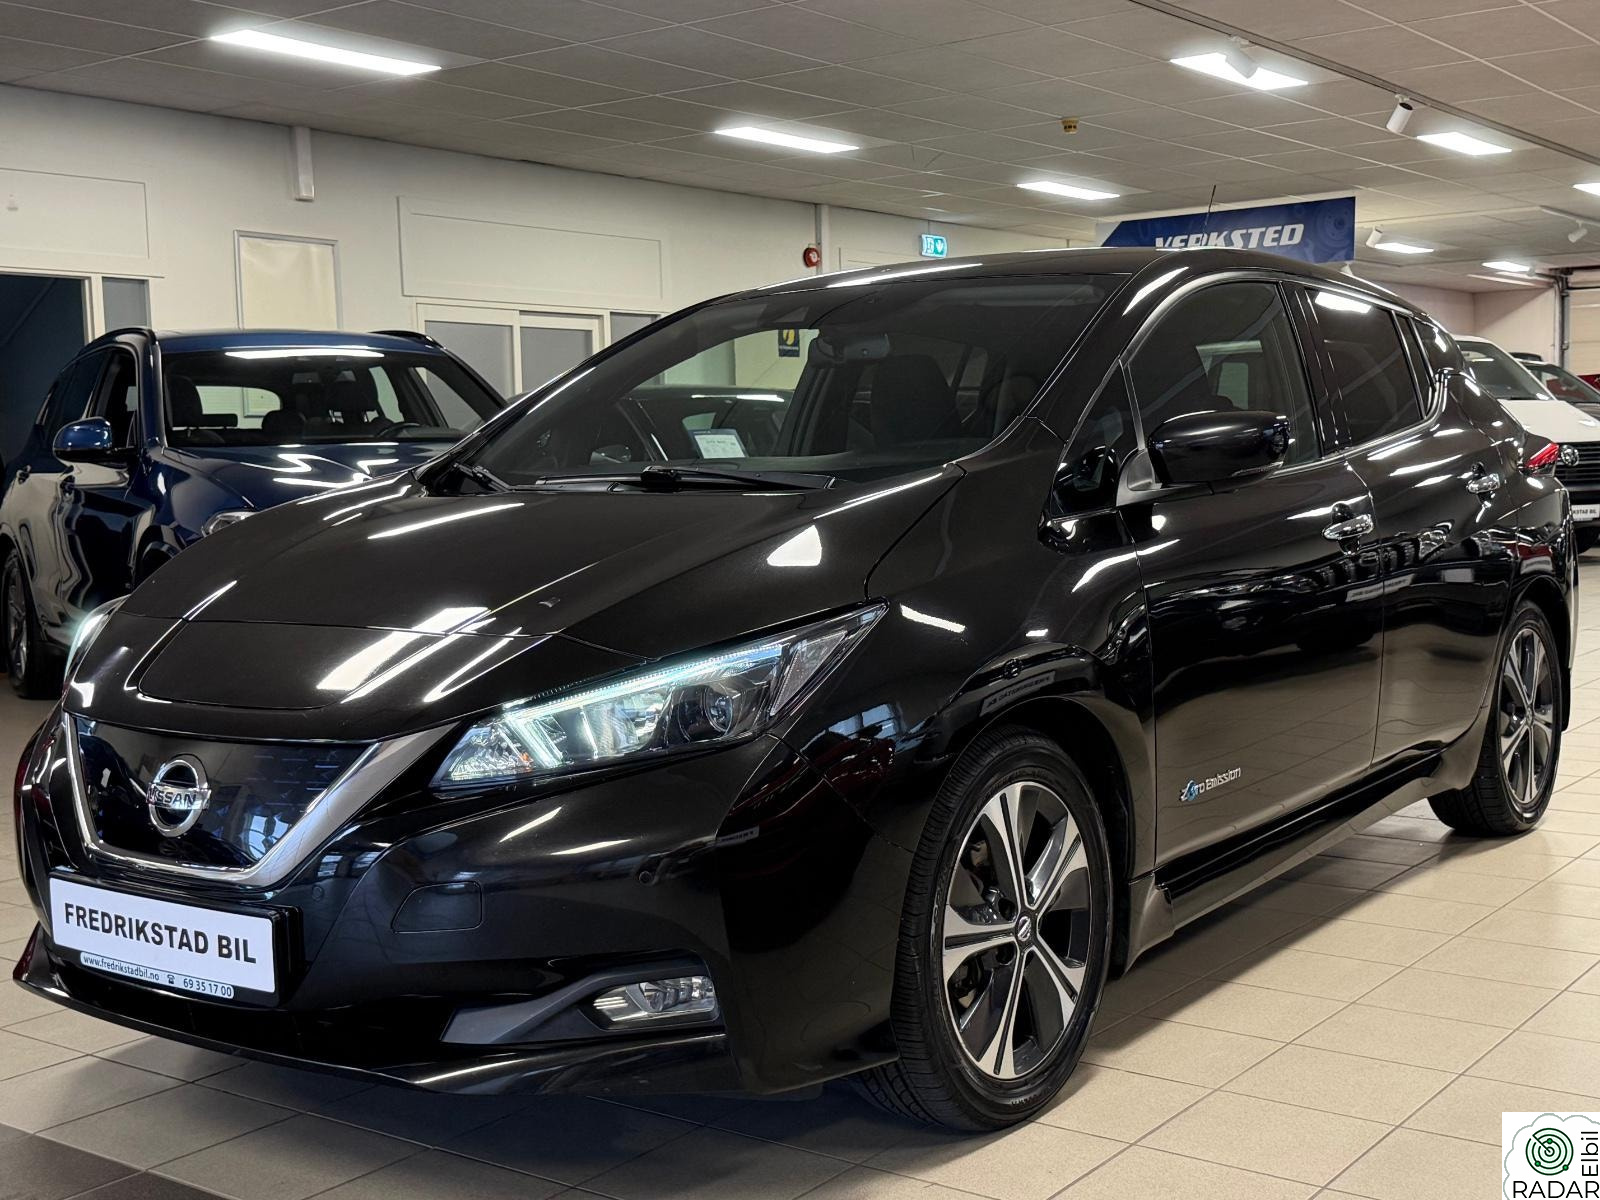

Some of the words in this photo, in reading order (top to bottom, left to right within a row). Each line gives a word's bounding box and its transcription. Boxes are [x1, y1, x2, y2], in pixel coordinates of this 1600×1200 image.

[147, 784, 197, 807] NISSAN
[1205, 767, 1241, 791] Emission
[64, 902, 209, 955] FREDRIKSTAD
[217, 934, 257, 964] BIL
[83, 955, 160, 981] www.fredrikstadbil.no
[183, 977, 194, 989] 69
[195, 980, 206, 992] 35
[208, 983, 219, 995] 17
[220, 985, 232, 997] 00
